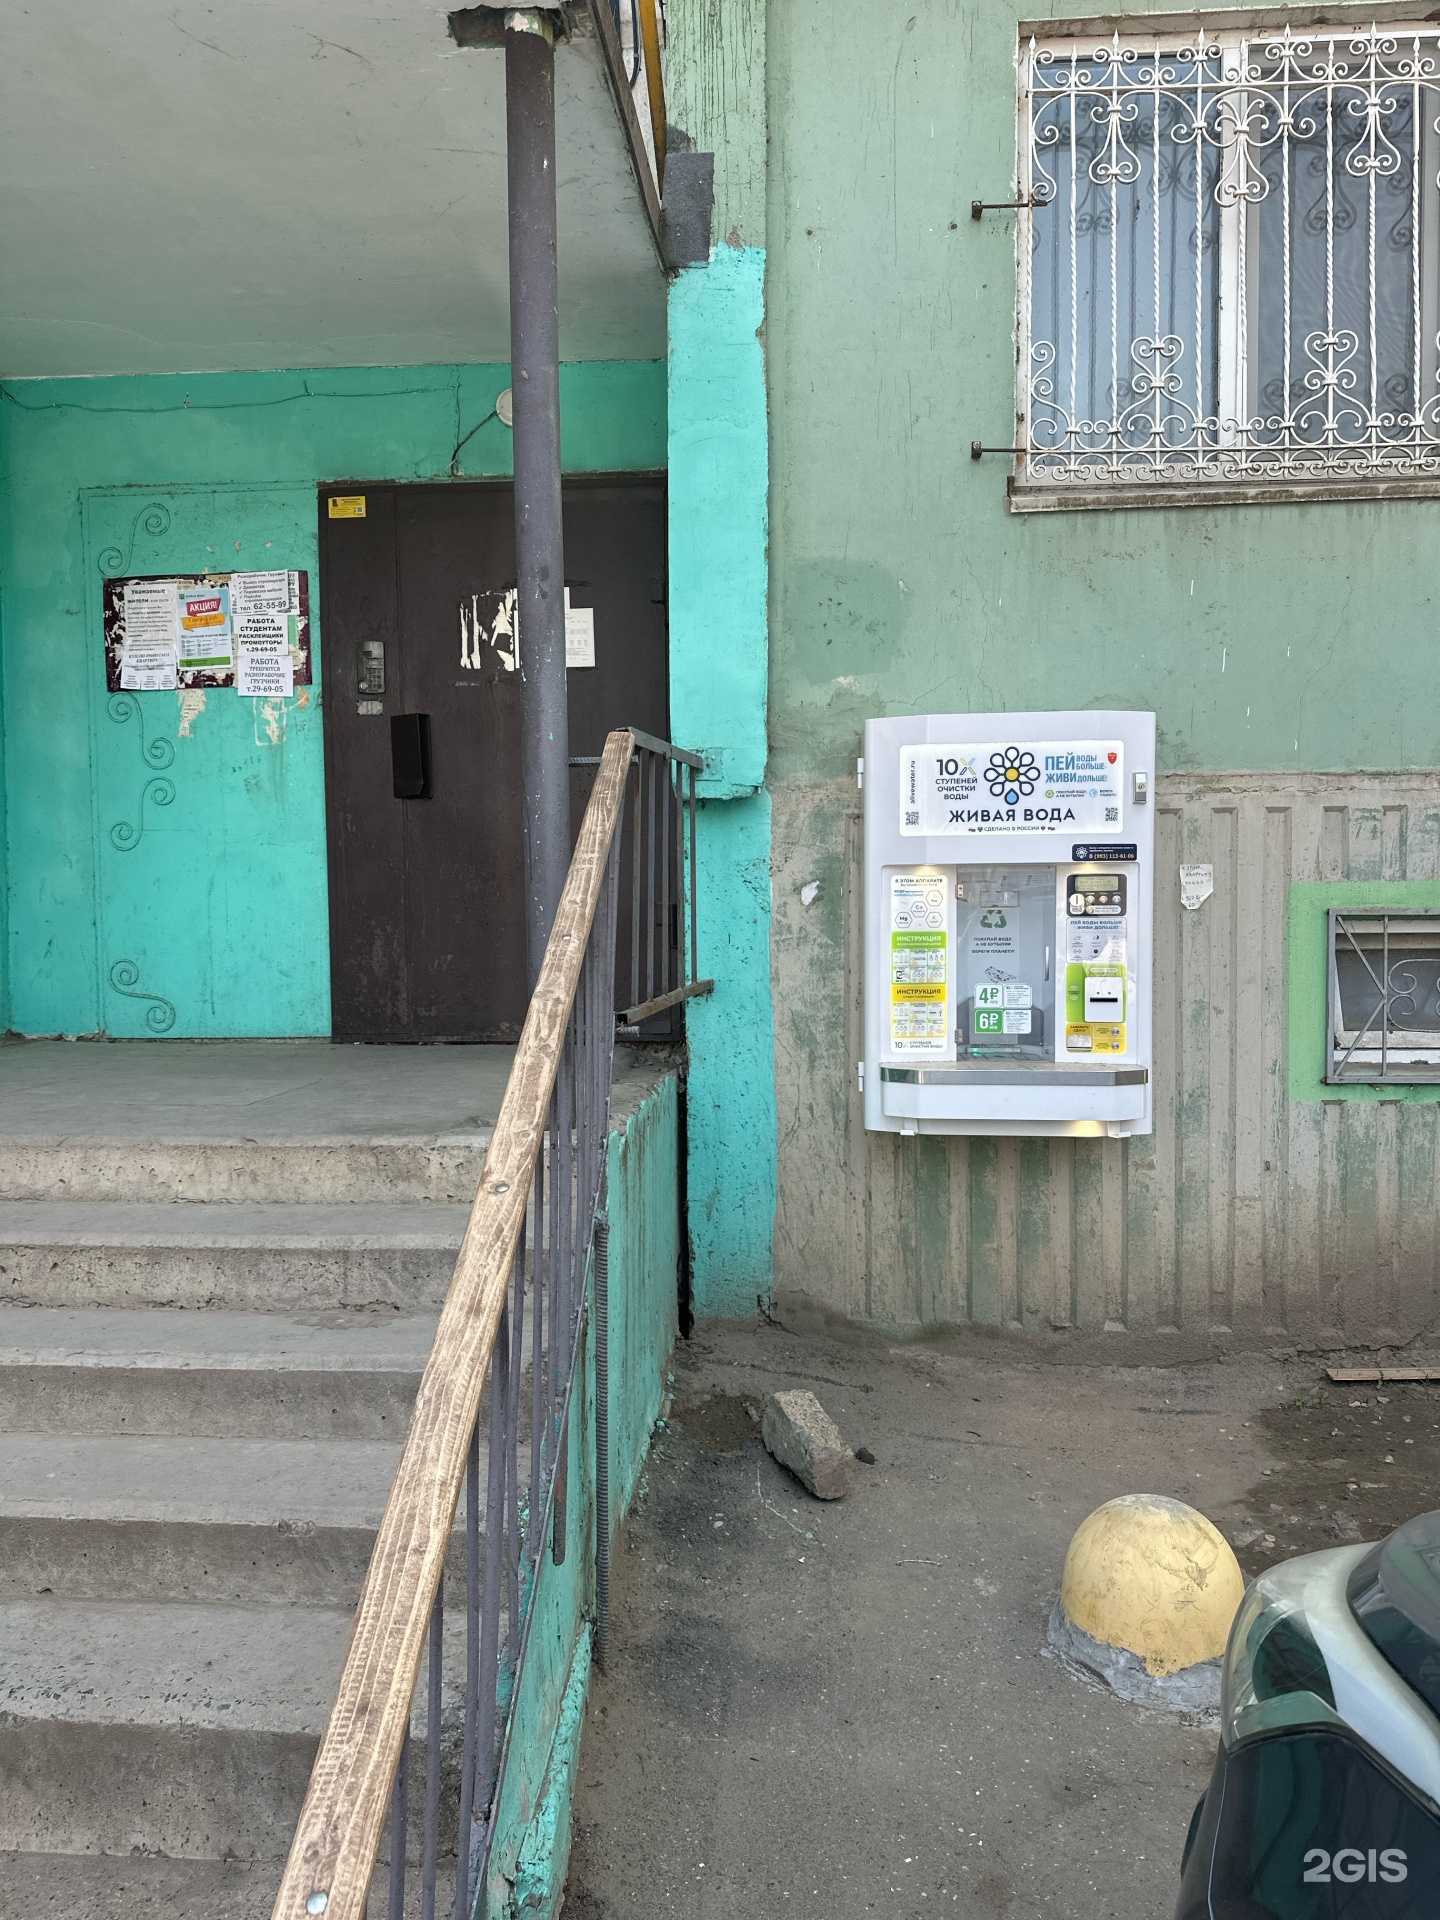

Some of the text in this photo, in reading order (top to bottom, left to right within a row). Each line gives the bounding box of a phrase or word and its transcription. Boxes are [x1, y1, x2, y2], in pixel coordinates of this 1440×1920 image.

[190, 601, 217, 612] АКЦИЯ!
[1045, 752, 1075, 771] ПЕЙ
[935, 777, 978, 785] СТУПЕНЕЙ
[1045, 772, 1077, 783] ЖИВИ
[937, 785, 976, 793] ОЧИСТКИ
[943, 793, 969, 801] ВОДЫ
[948, 807, 1076, 823] ЖИВАЯ ВОДА
